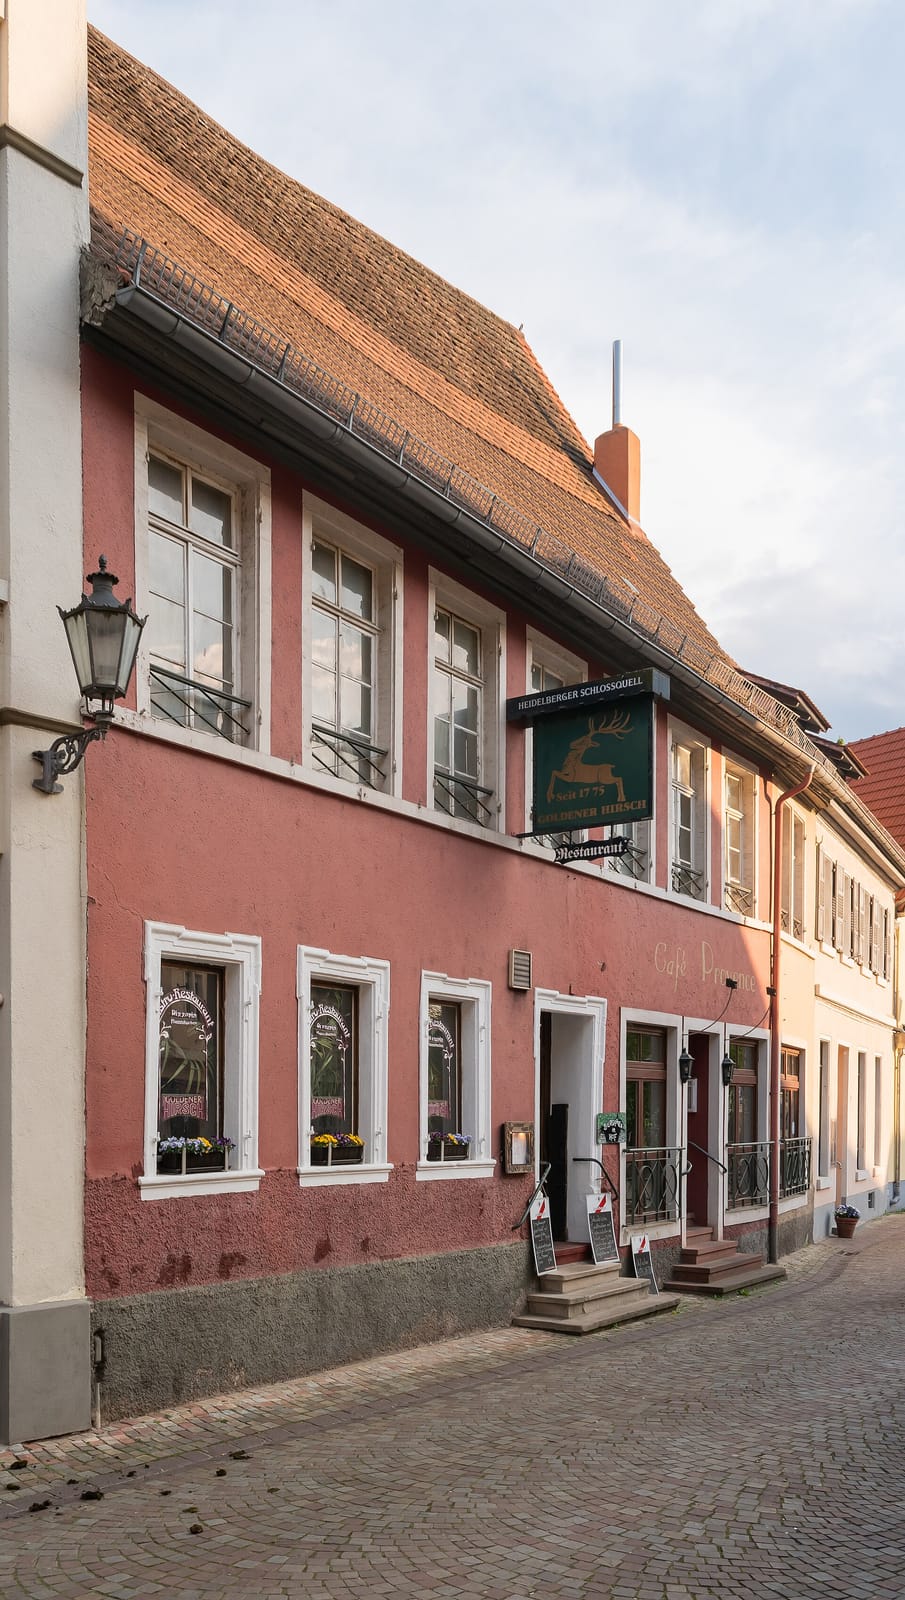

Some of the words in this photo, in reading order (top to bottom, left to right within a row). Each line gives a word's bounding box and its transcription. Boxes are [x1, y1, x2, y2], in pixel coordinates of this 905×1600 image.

[518, 690, 578, 711] HEIDELBERGER
[580, 676, 643, 697] SCHLOSSQUELL
[556, 790, 577, 801] Seit
[537, 807, 597, 823] GOLDENER
[601, 800, 647, 815] HIRSCH
[555, 841, 624, 860] Restaurant
